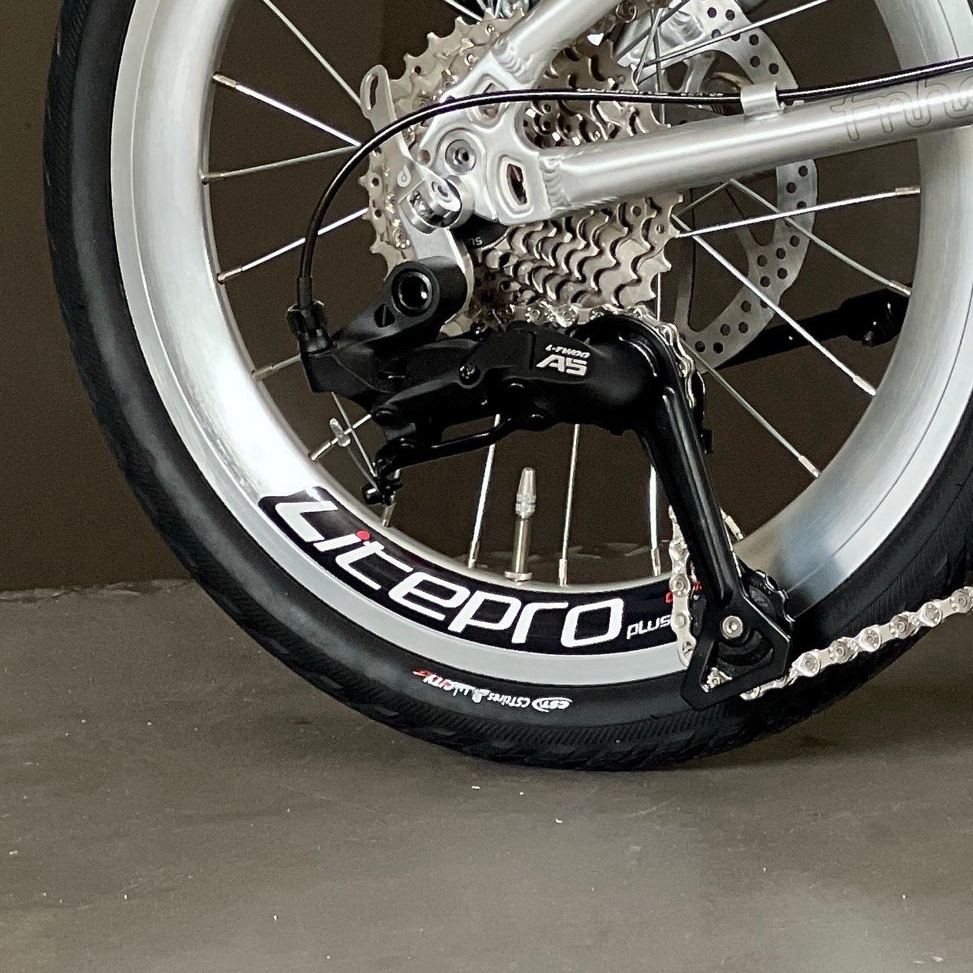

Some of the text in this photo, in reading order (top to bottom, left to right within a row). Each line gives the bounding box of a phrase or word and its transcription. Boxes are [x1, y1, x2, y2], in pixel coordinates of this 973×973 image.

[536, 354, 588, 376] A5
[275, 501, 672, 649] Litepro plus
